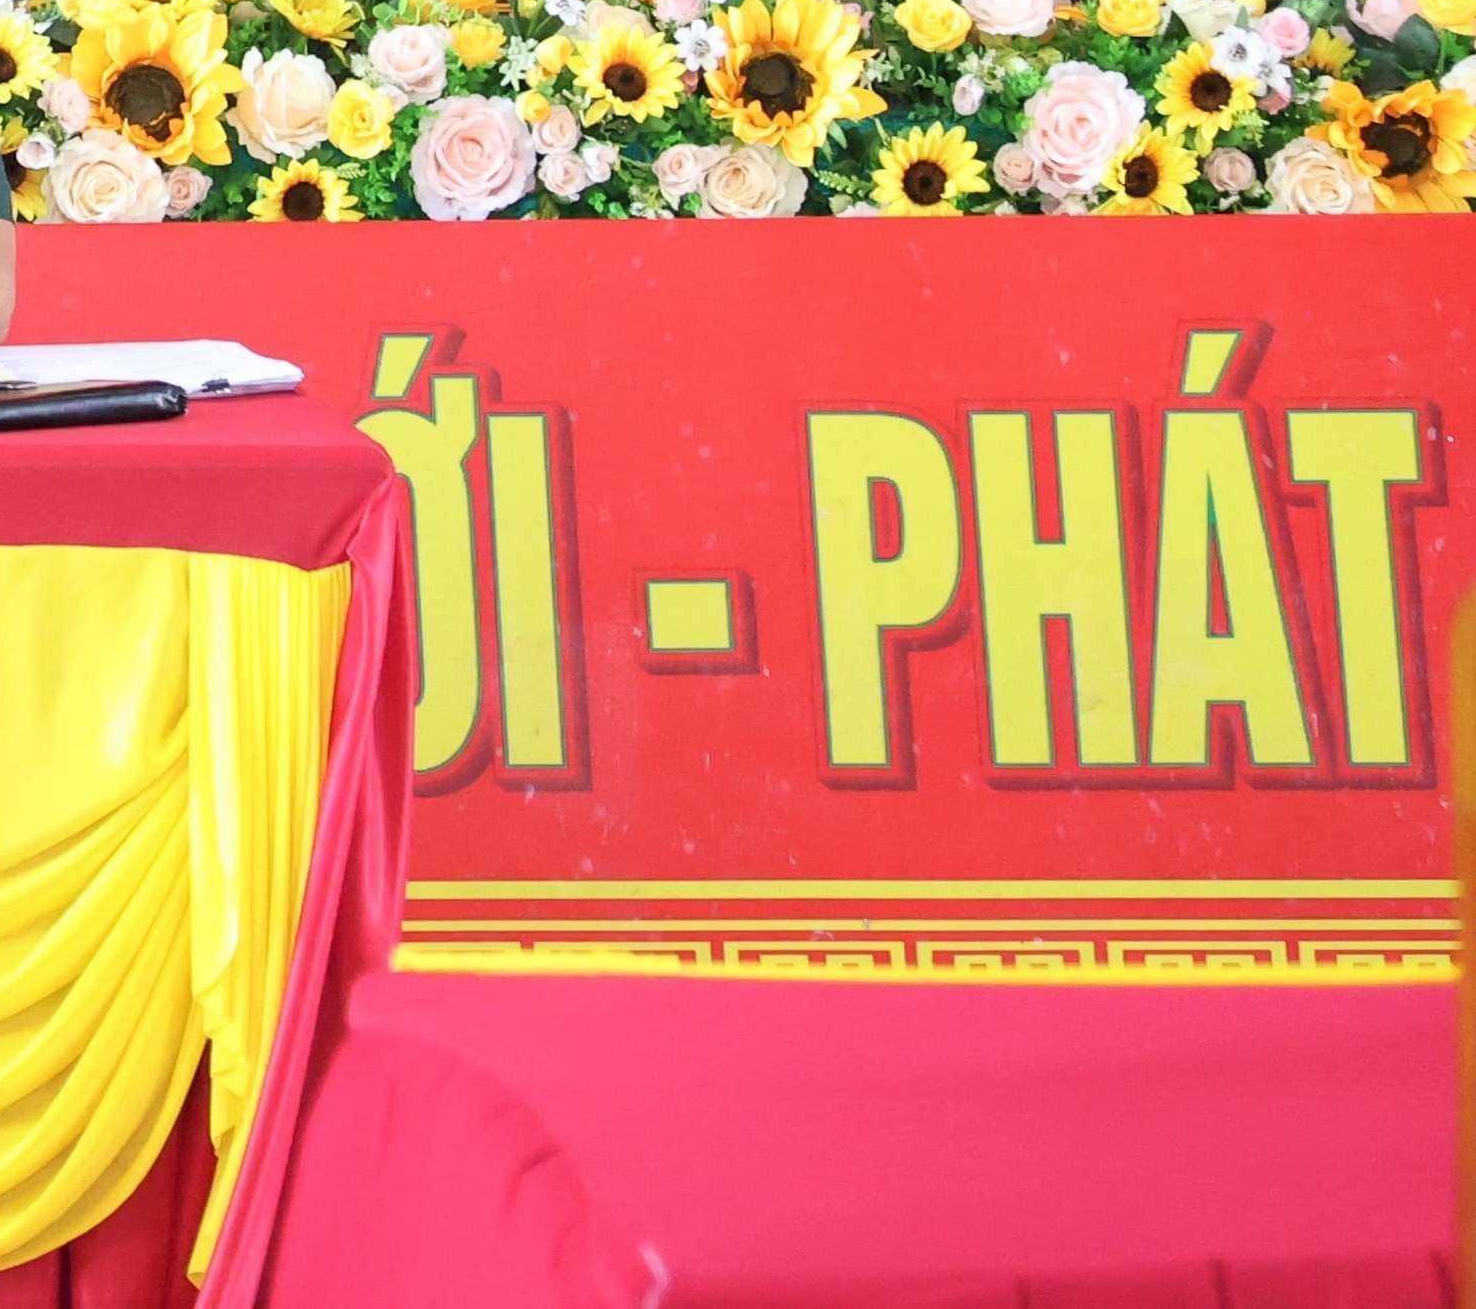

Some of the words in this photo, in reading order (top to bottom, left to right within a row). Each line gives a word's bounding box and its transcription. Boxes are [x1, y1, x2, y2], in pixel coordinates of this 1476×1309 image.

[355, 333, 566, 774] ỚI
[646, 578, 732, 652] -
[805, 329, 1420, 767] PHÁT
